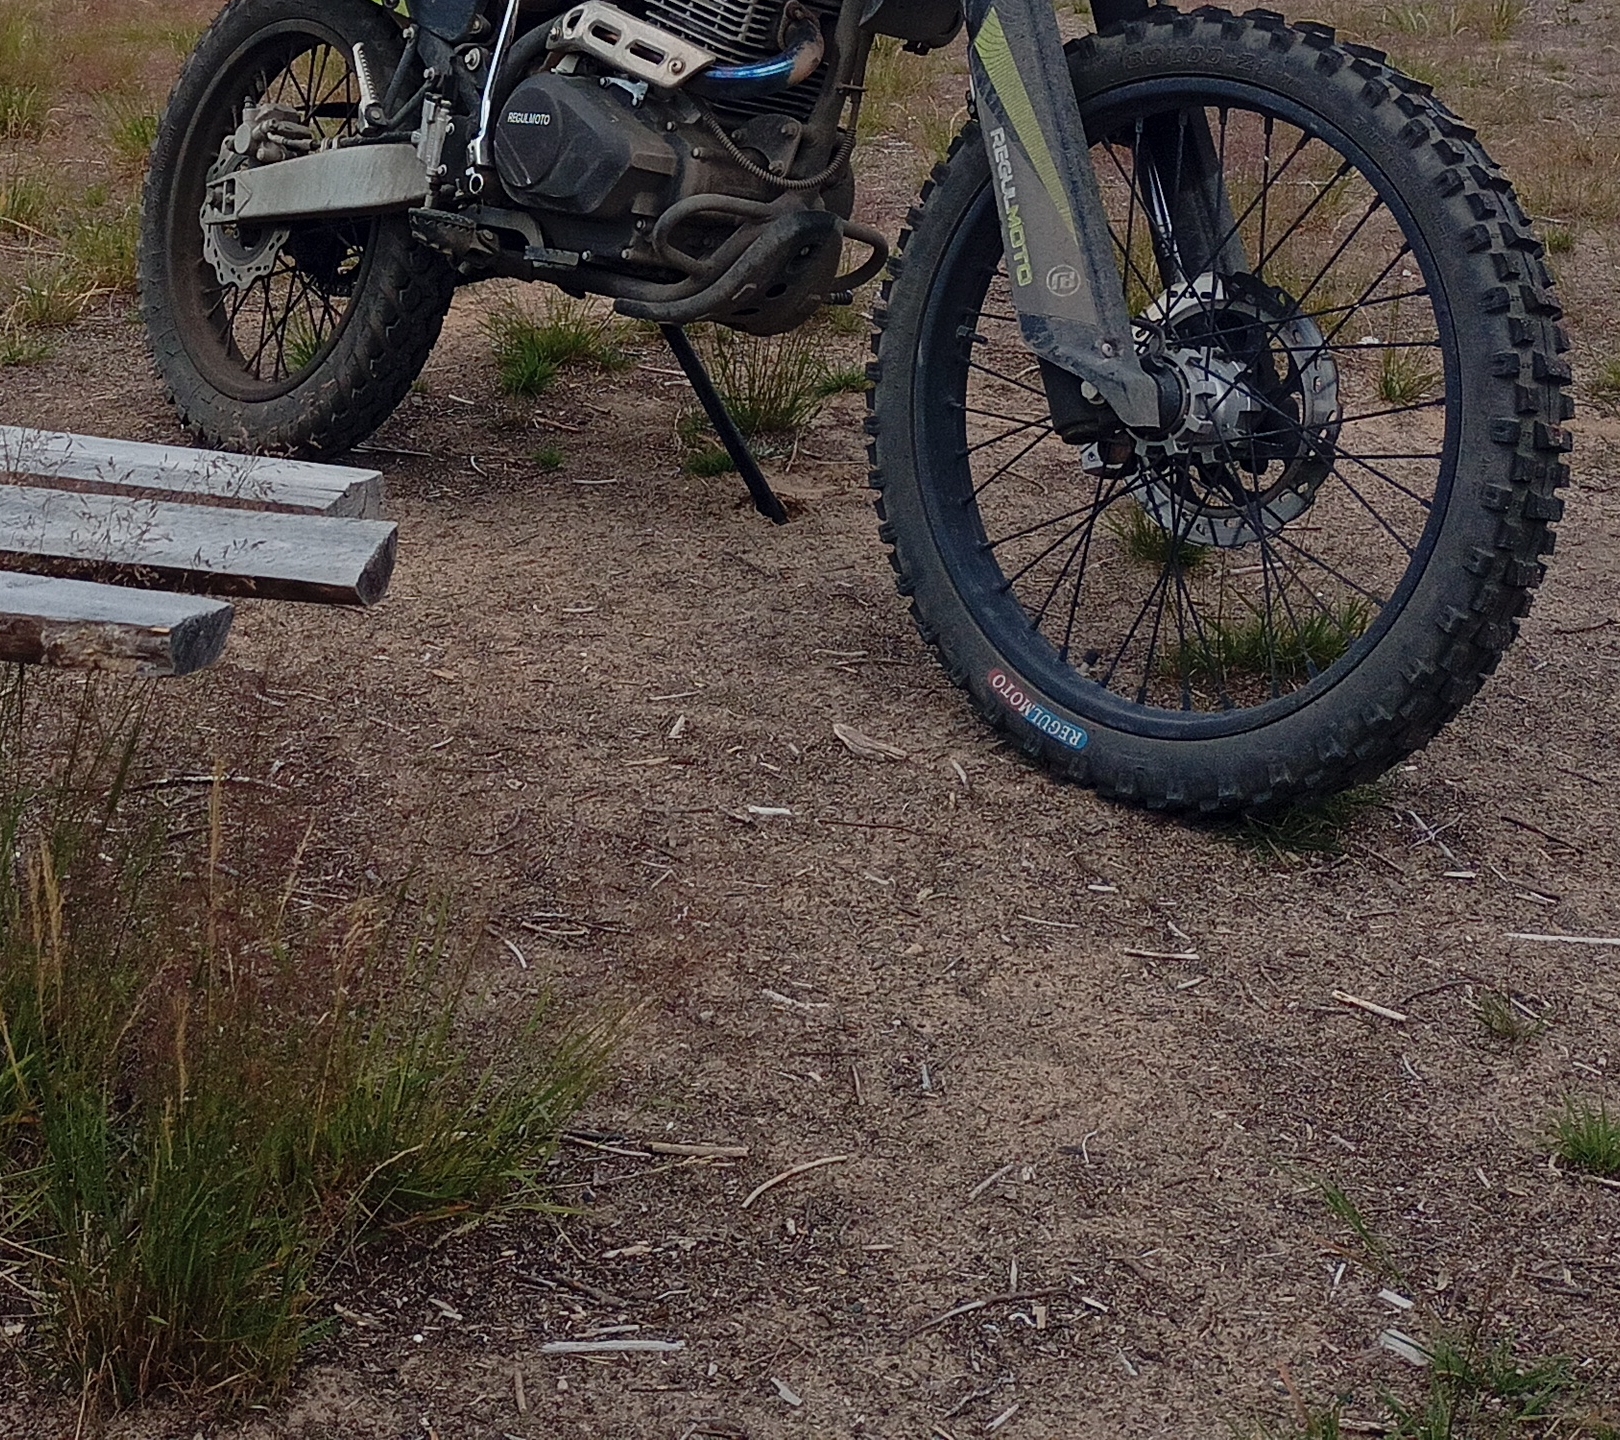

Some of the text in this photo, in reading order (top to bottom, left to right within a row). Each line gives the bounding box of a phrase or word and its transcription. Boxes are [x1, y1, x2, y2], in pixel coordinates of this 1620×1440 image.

[507, 111, 551, 125] REGULMOTO
[990, 127, 1033, 288] REGULMOTO
[992, 674, 1082, 746] REGULMOTO
